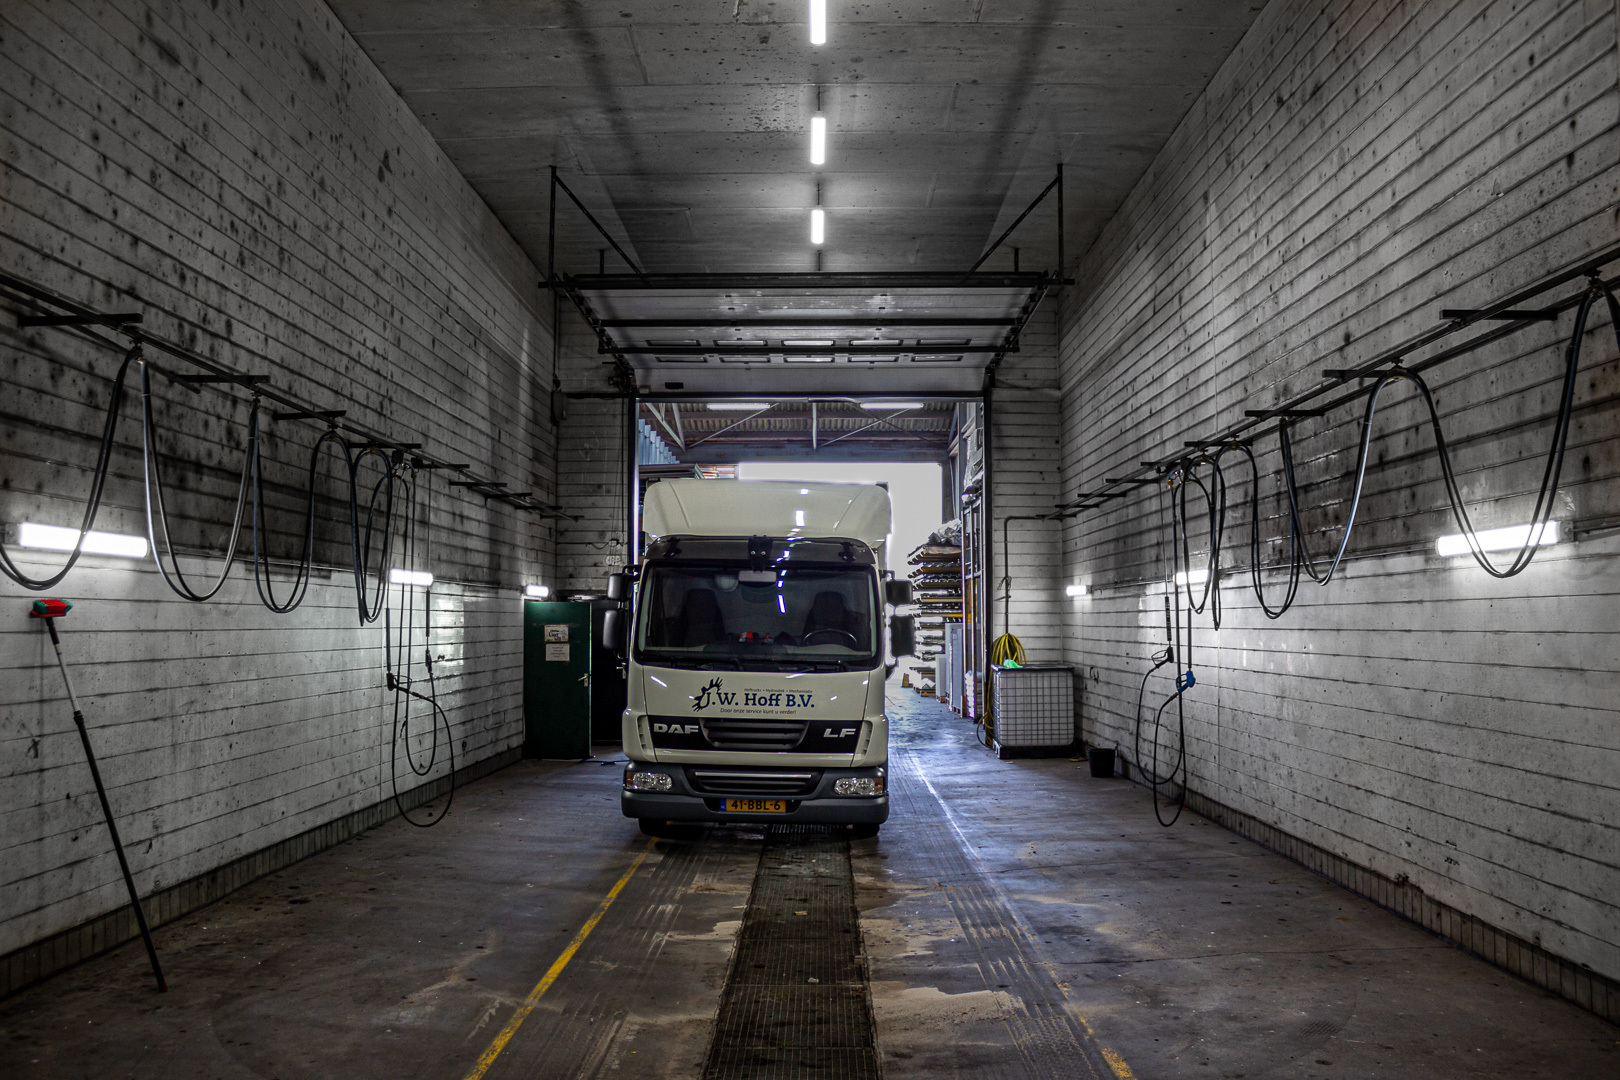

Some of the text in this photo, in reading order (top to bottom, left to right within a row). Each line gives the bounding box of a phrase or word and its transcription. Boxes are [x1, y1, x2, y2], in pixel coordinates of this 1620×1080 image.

[744, 693, 782, 706] Hoff
[786, 694, 815, 708] B.V.
[654, 723, 698, 734] DAF
[824, 728, 856, 738] LF
[731, 800, 781, 810] 41-BBL-6
